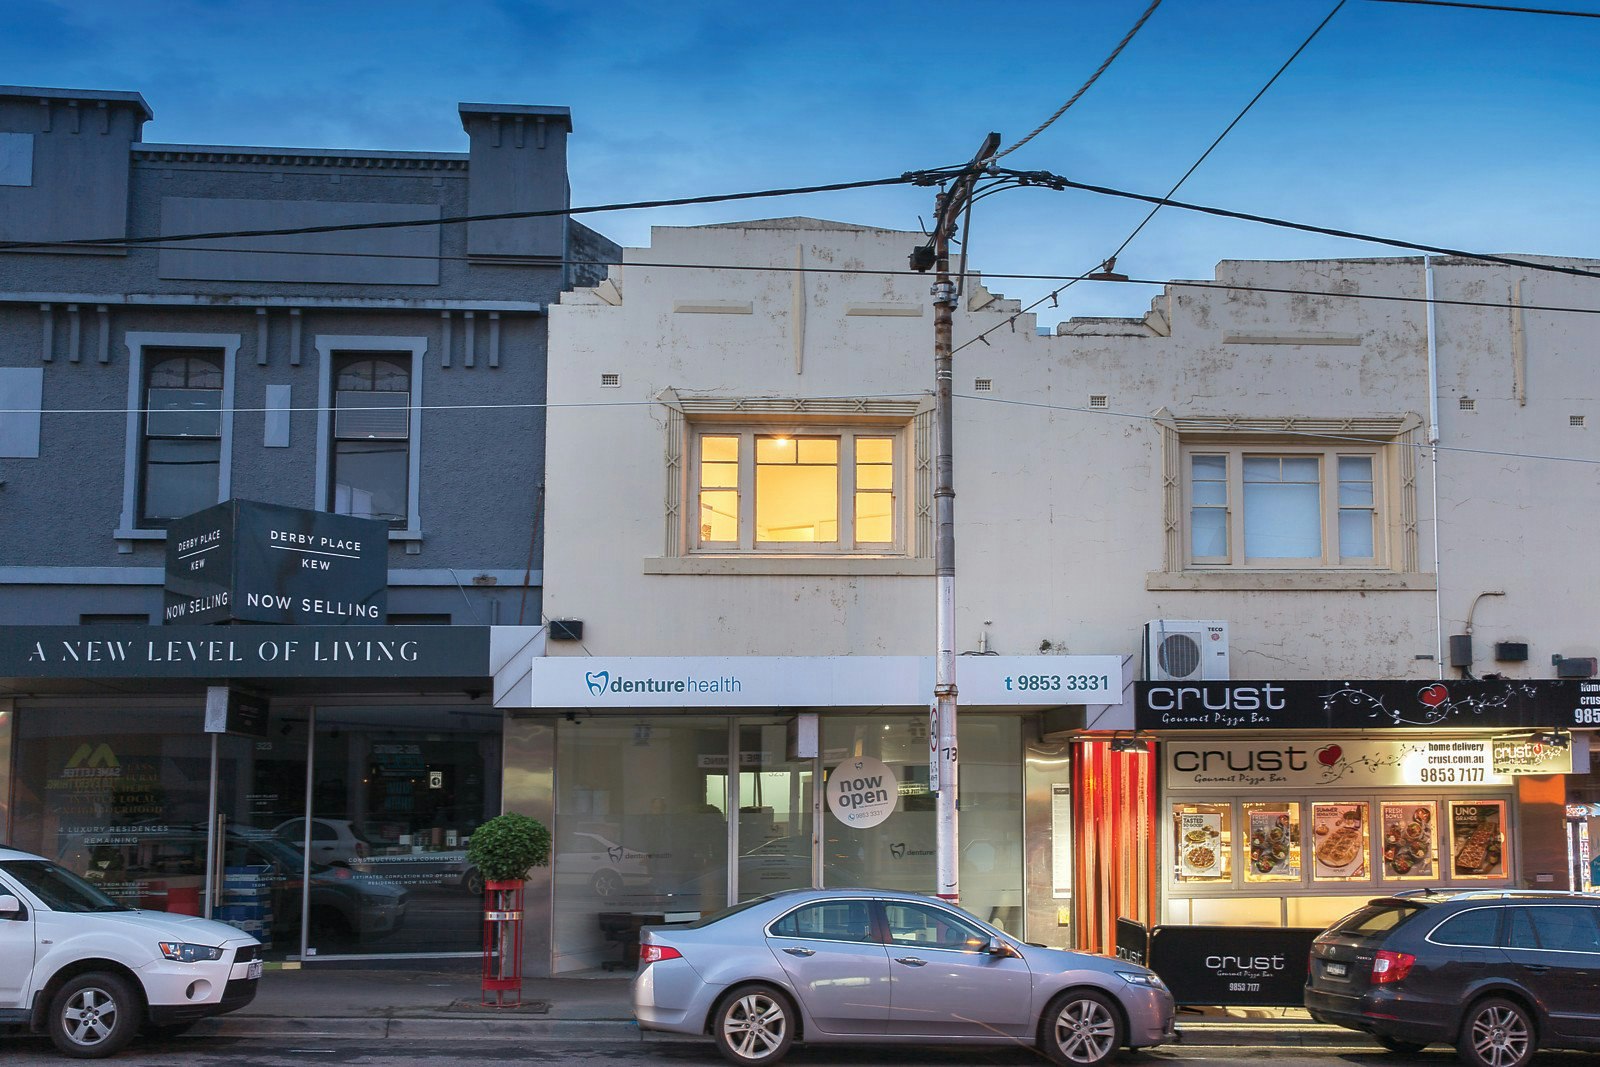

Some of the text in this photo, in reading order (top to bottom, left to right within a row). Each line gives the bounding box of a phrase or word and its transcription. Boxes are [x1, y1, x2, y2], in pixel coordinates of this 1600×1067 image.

[178, 529, 221, 552] DERBY PLACE
[270, 530, 362, 552] DERBY PLACE
[190, 558, 205, 571] KEW
[302, 559, 331, 571] KEW
[166, 591, 228, 620] NOW SELLING
[247, 592, 379, 619] NOW SELLING
[29, 641, 420, 662] A NEW LEVEL OF LIVING
[1004, 675, 1109, 691] t 9853 3331
[1147, 683, 1285, 711] crust
[1162, 713, 1271, 726] Gourmet Pizza Bar
[1428, 742, 1484, 753] home delivery
[1494, 742, 1532, 759] crust
[1173, 746, 1307, 772] crust
[1428, 754, 1485, 764] crust.com.au
[1194, 774, 1288, 785] Gourmet Pizza Bar
[1420, 768, 1456, 782] 9853
[1459, 768, 1485, 782] 7177
[840, 776, 883, 792] now
[838, 789, 888, 809] open
[1455, 807, 1477, 815] UNO
[1205, 955, 1285, 970] crust
[1244, 970, 1260, 979] Pizza
[1229, 983, 1260, 992] 9853 7177
